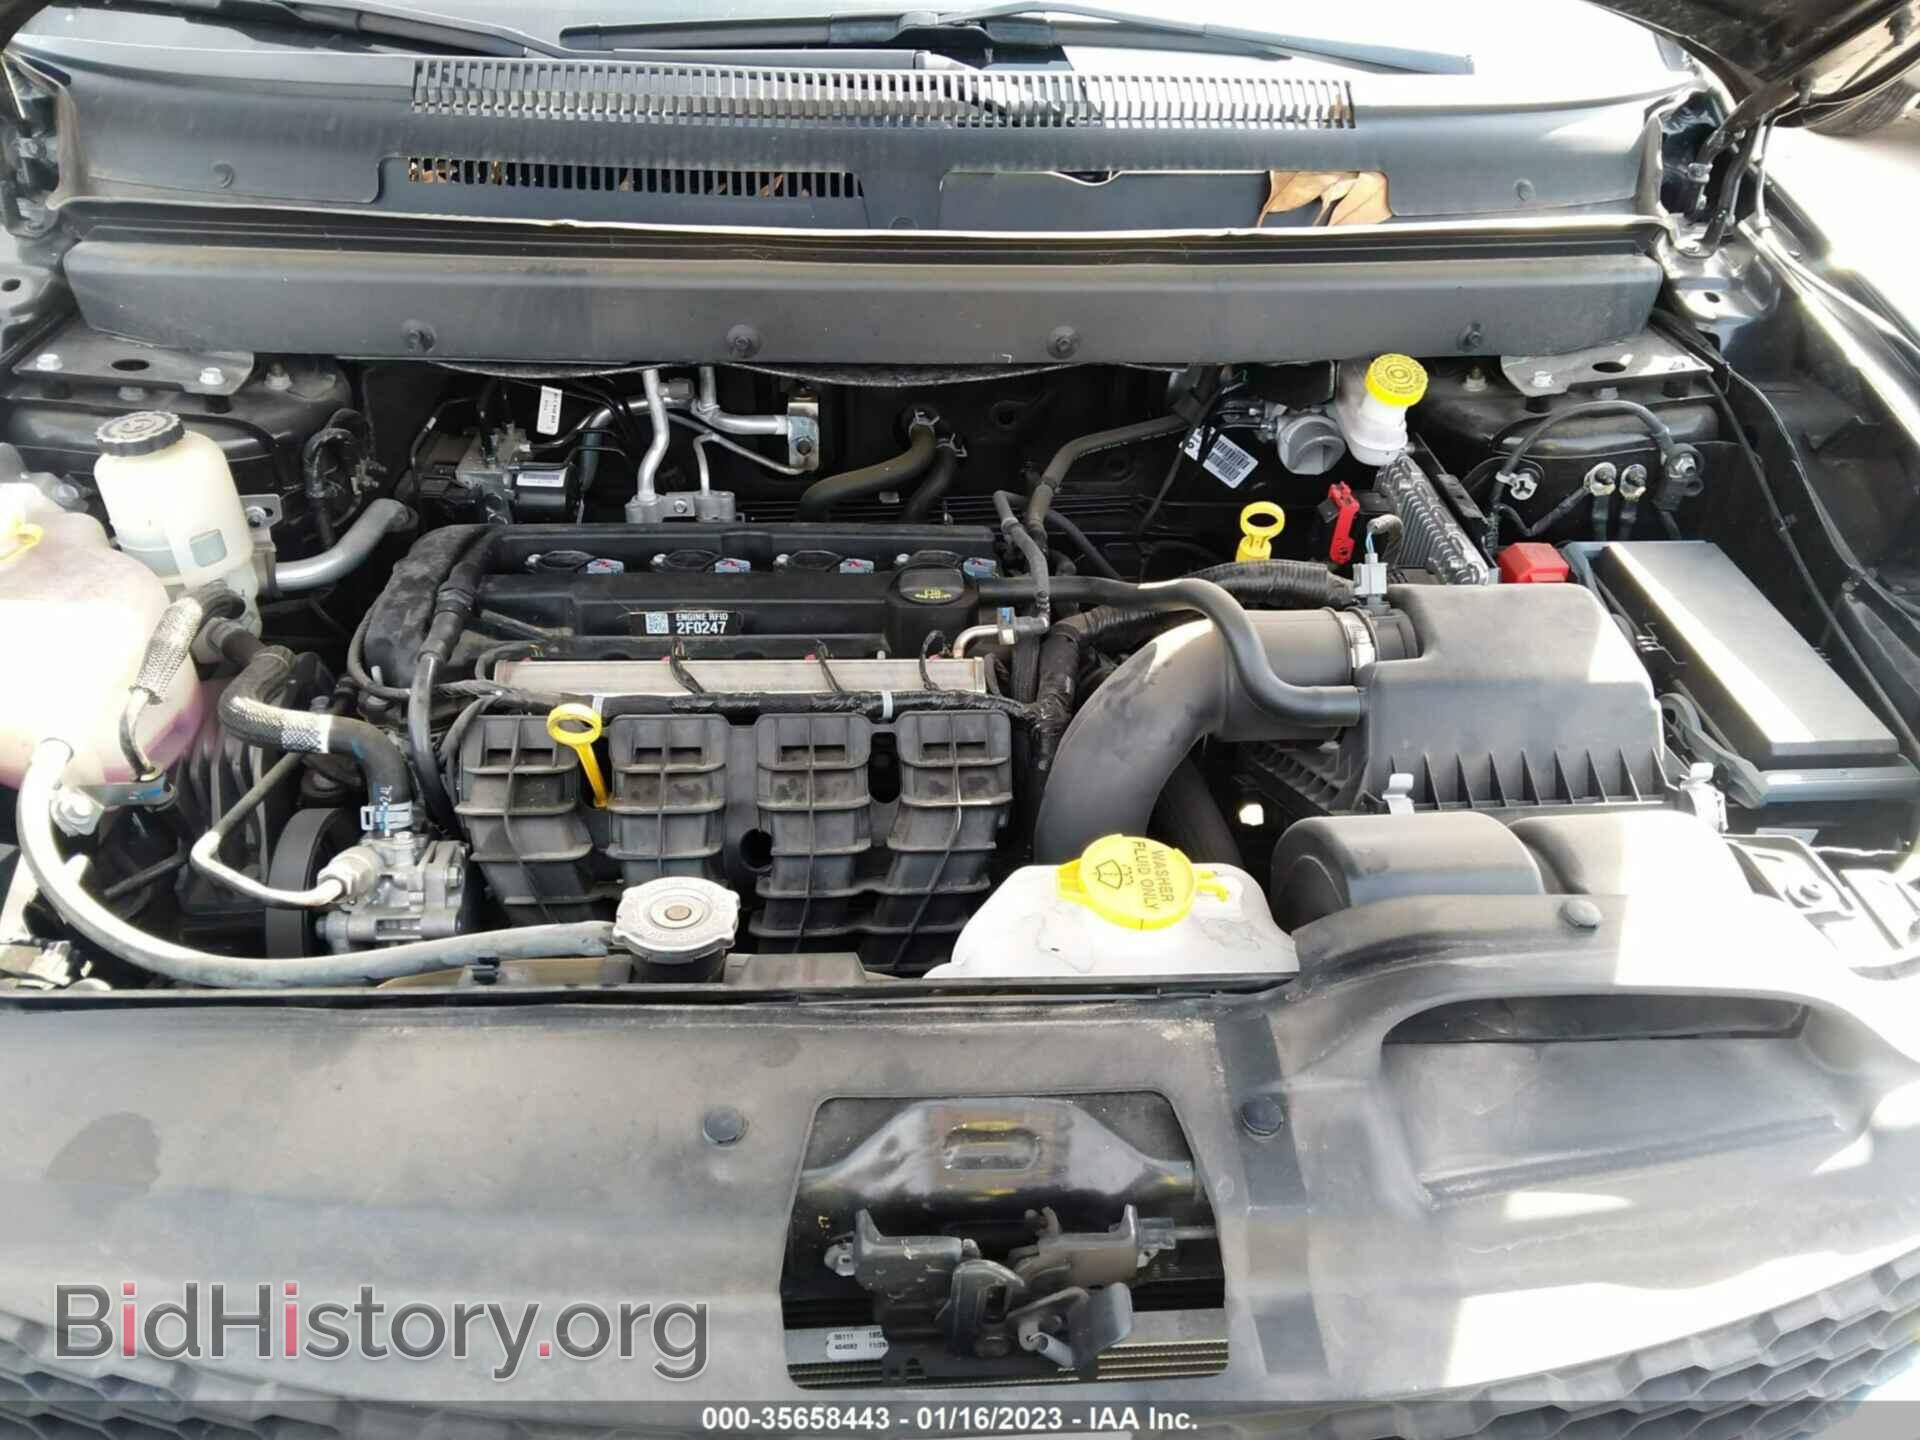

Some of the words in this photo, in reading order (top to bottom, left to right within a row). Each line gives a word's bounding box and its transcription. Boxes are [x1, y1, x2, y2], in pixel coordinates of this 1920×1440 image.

[675, 612, 706, 621] ENGINE
[708, 612, 729, 621] RFID
[676, 621, 727, 635] 2F0247
[1133, 841, 1150, 876] FLUID
[1151, 849, 1175, 903] WASHER
[1140, 879, 1159, 910] ONLY
